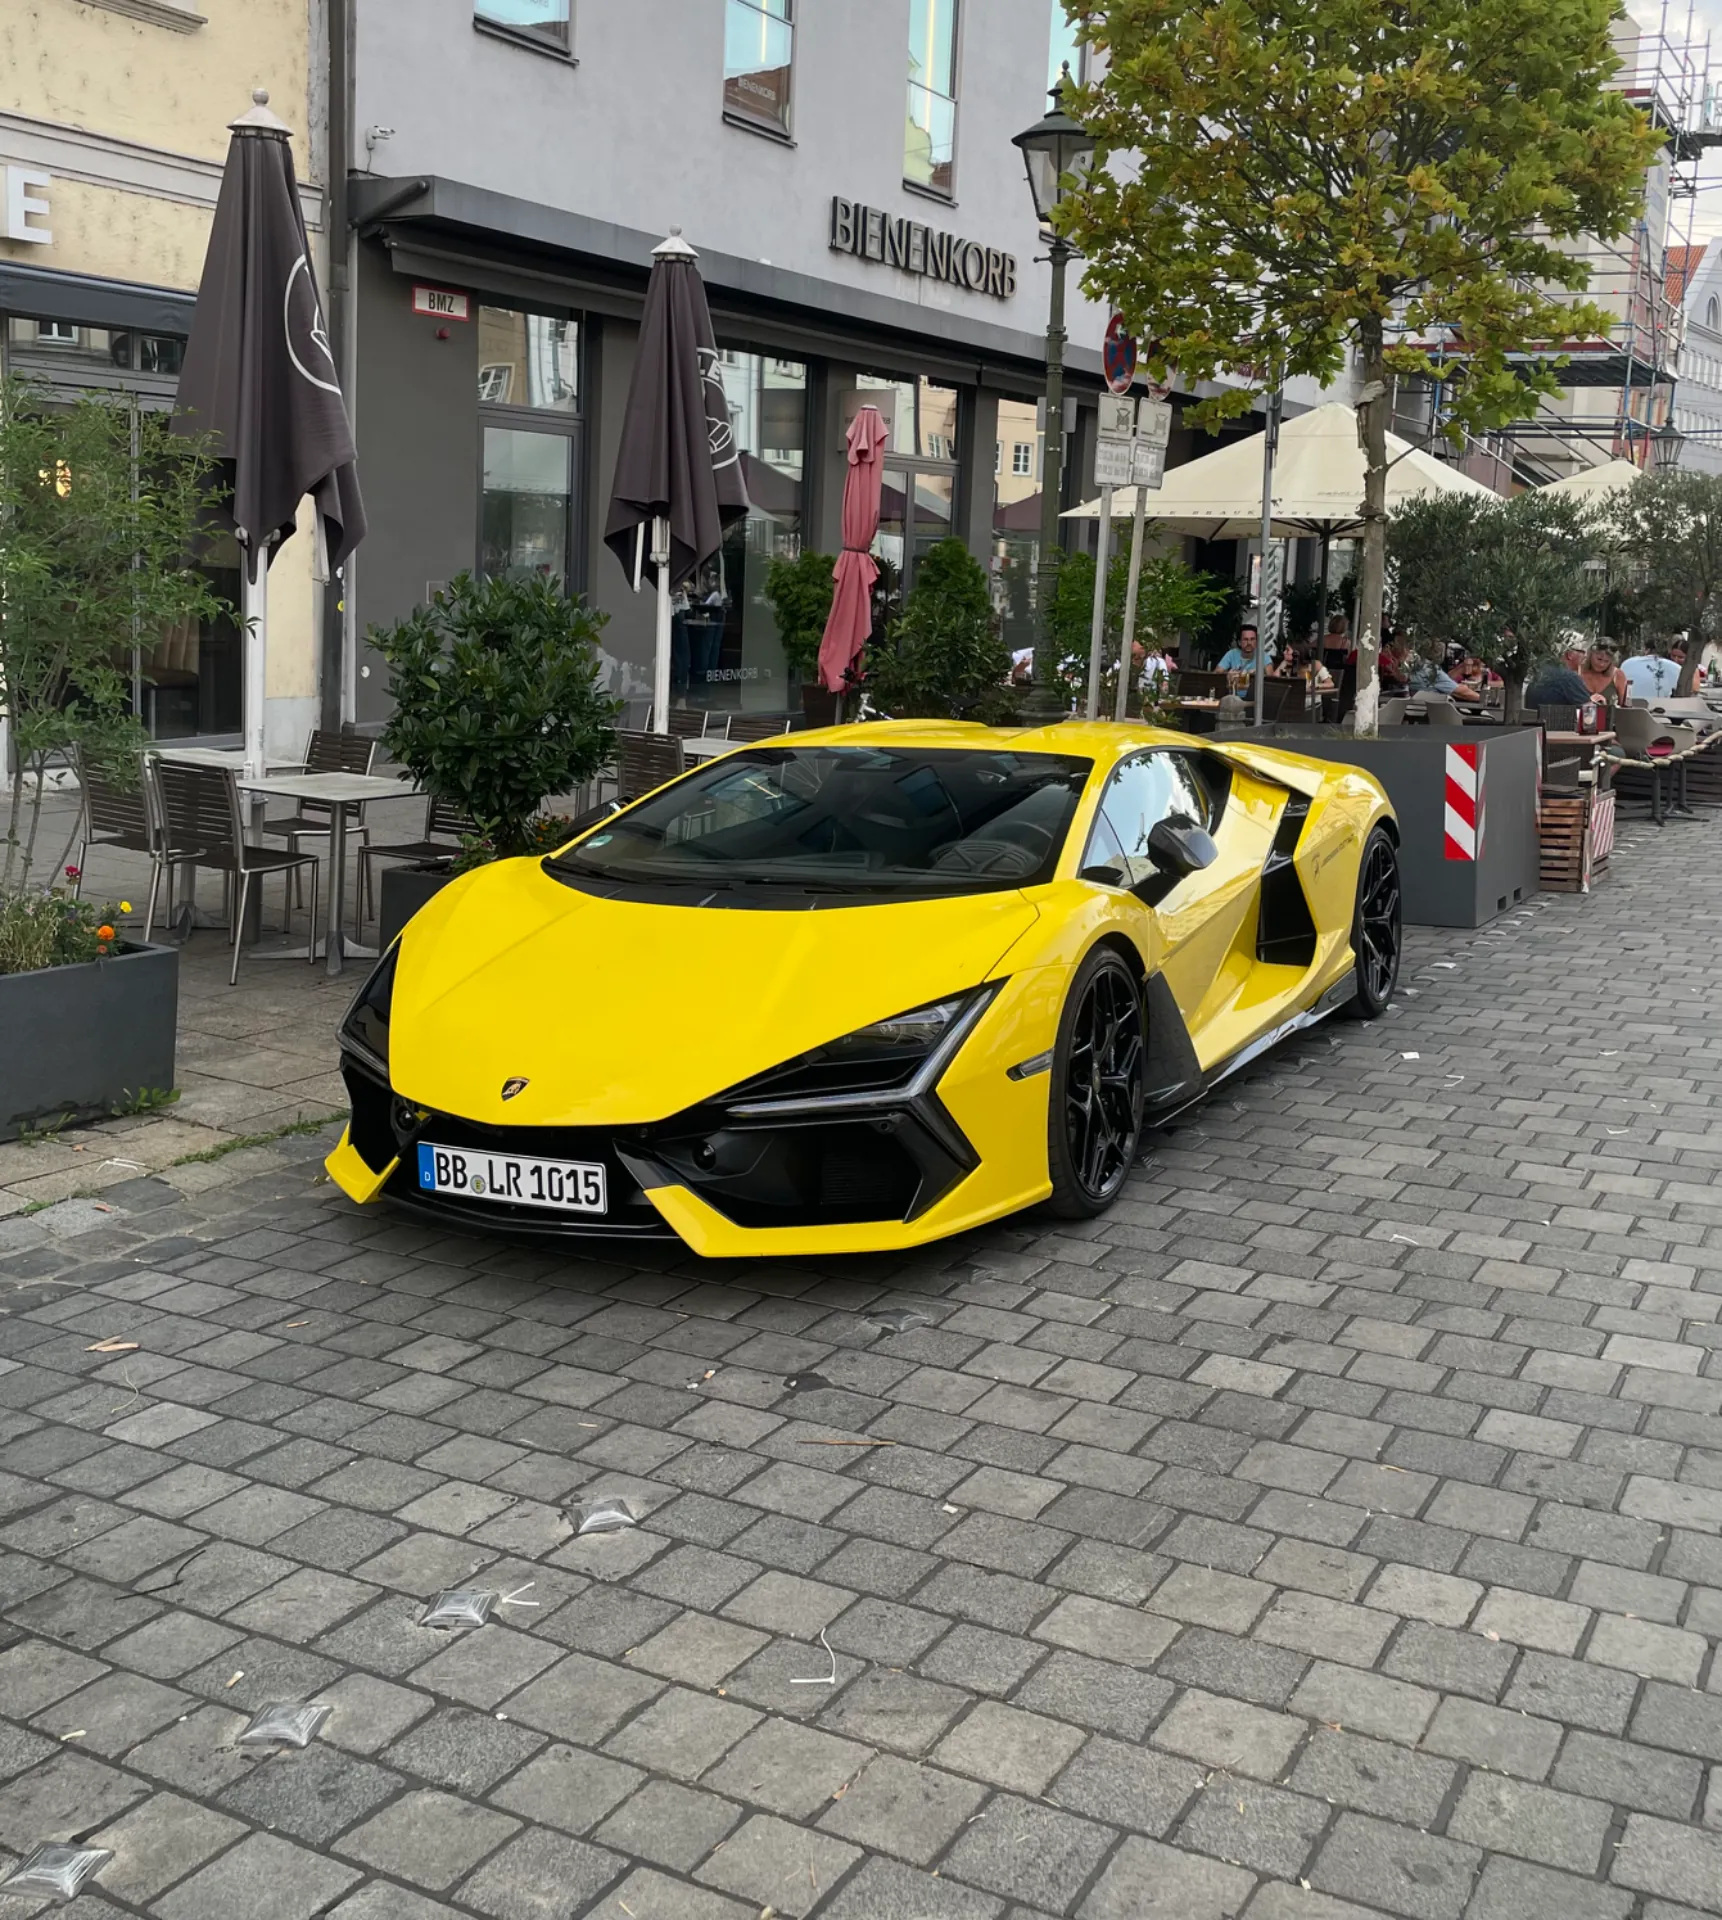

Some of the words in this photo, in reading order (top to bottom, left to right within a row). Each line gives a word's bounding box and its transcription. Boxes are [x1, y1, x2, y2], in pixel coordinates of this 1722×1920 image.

[832, 195, 1018, 298] BIENENKORB
[428, 292, 454, 313] BMZ
[706, 667, 758, 682] BIENENKORB
[424, 1171, 431, 1182] D
[435, 1152, 468, 1189] BB
[488, 1159, 523, 1197] LR
[530, 1165, 601, 1206] 1015
